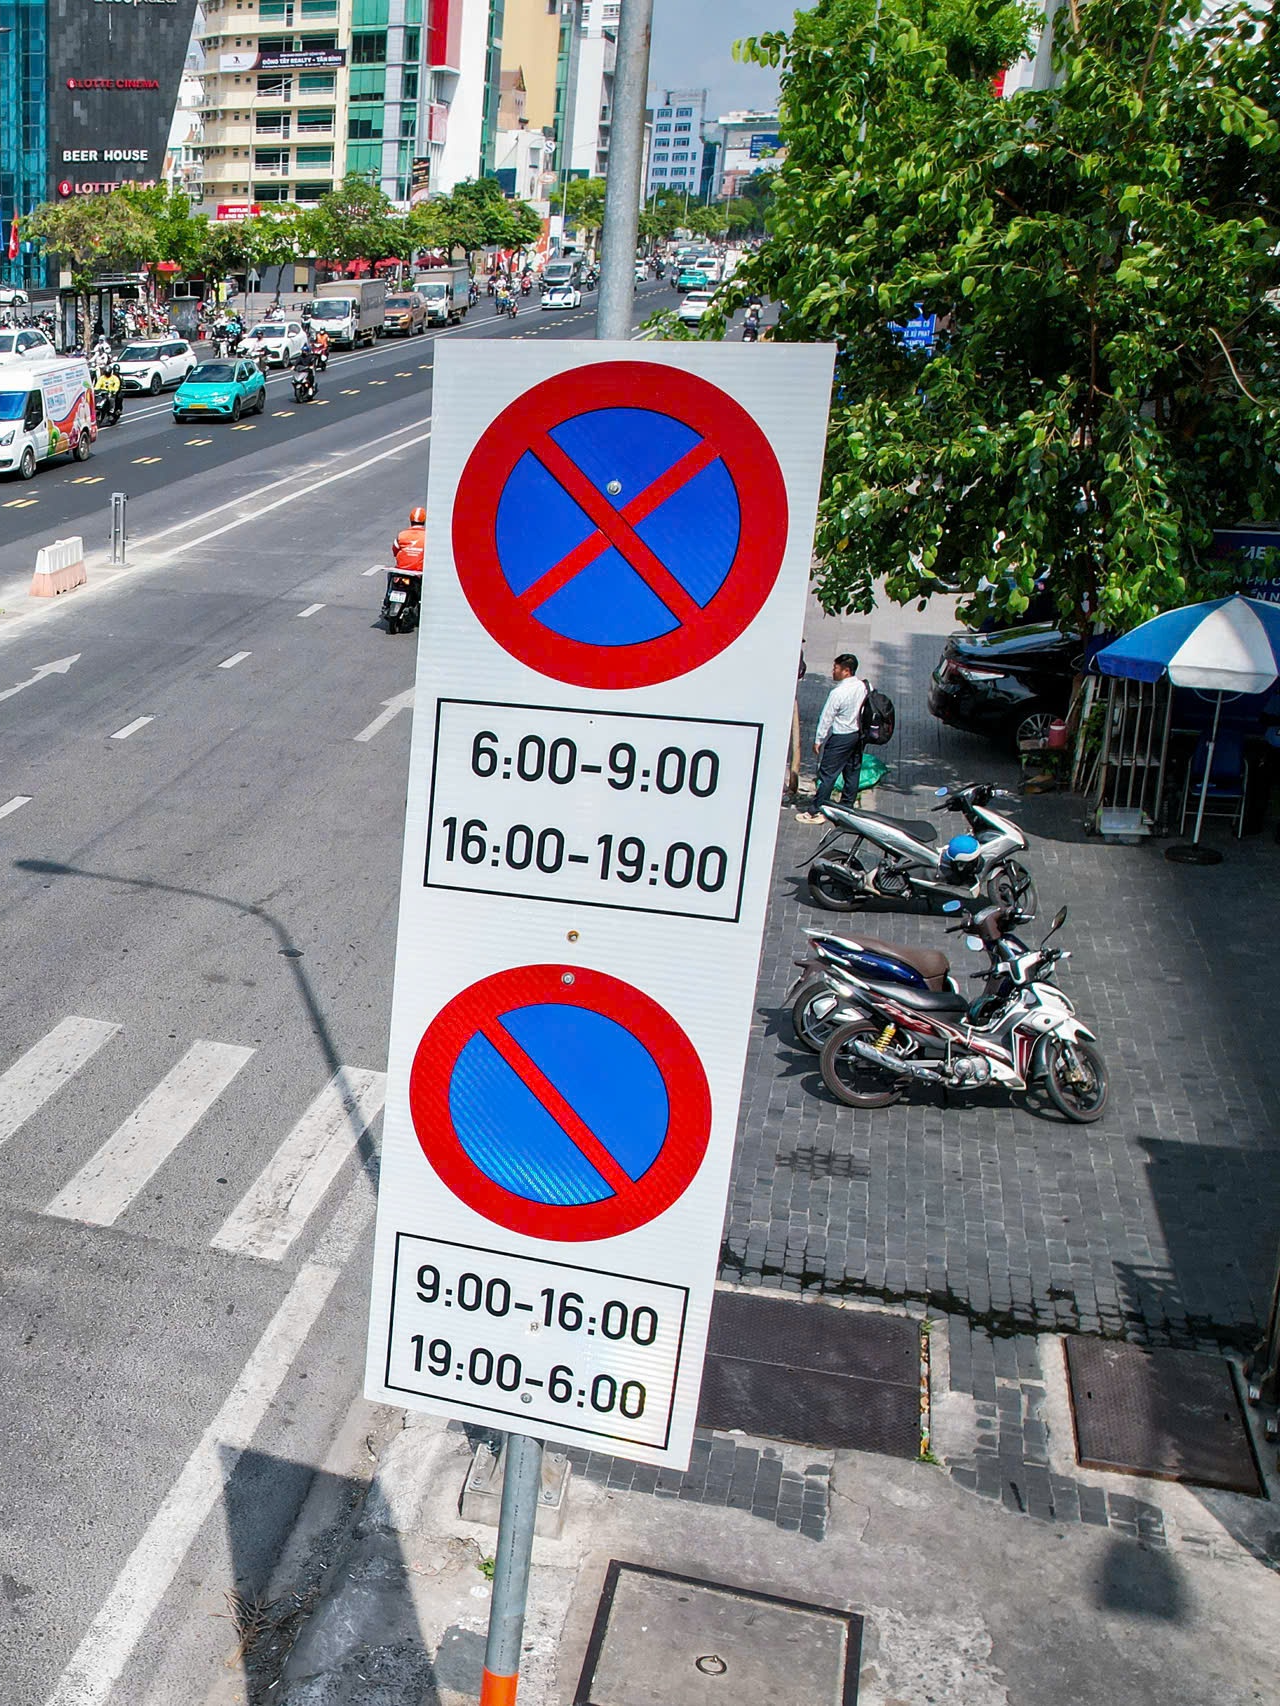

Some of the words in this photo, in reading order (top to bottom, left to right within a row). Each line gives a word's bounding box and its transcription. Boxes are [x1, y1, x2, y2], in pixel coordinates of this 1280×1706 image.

[77, 79, 113, 89] LOTTE
[115, 78, 159, 88] CINEMA
[63, 150, 98, 162] BEER
[104, 149, 148, 161] HOUSE
[75, 182, 120, 194] LOTTE
[471, 730, 720, 798] 6:00-9:00
[442, 816, 728, 893] 16:00-19:00
[416, 1264, 658, 1346] 9:00-16:00
[411, 1334, 646, 1419] 19:00-6:00
